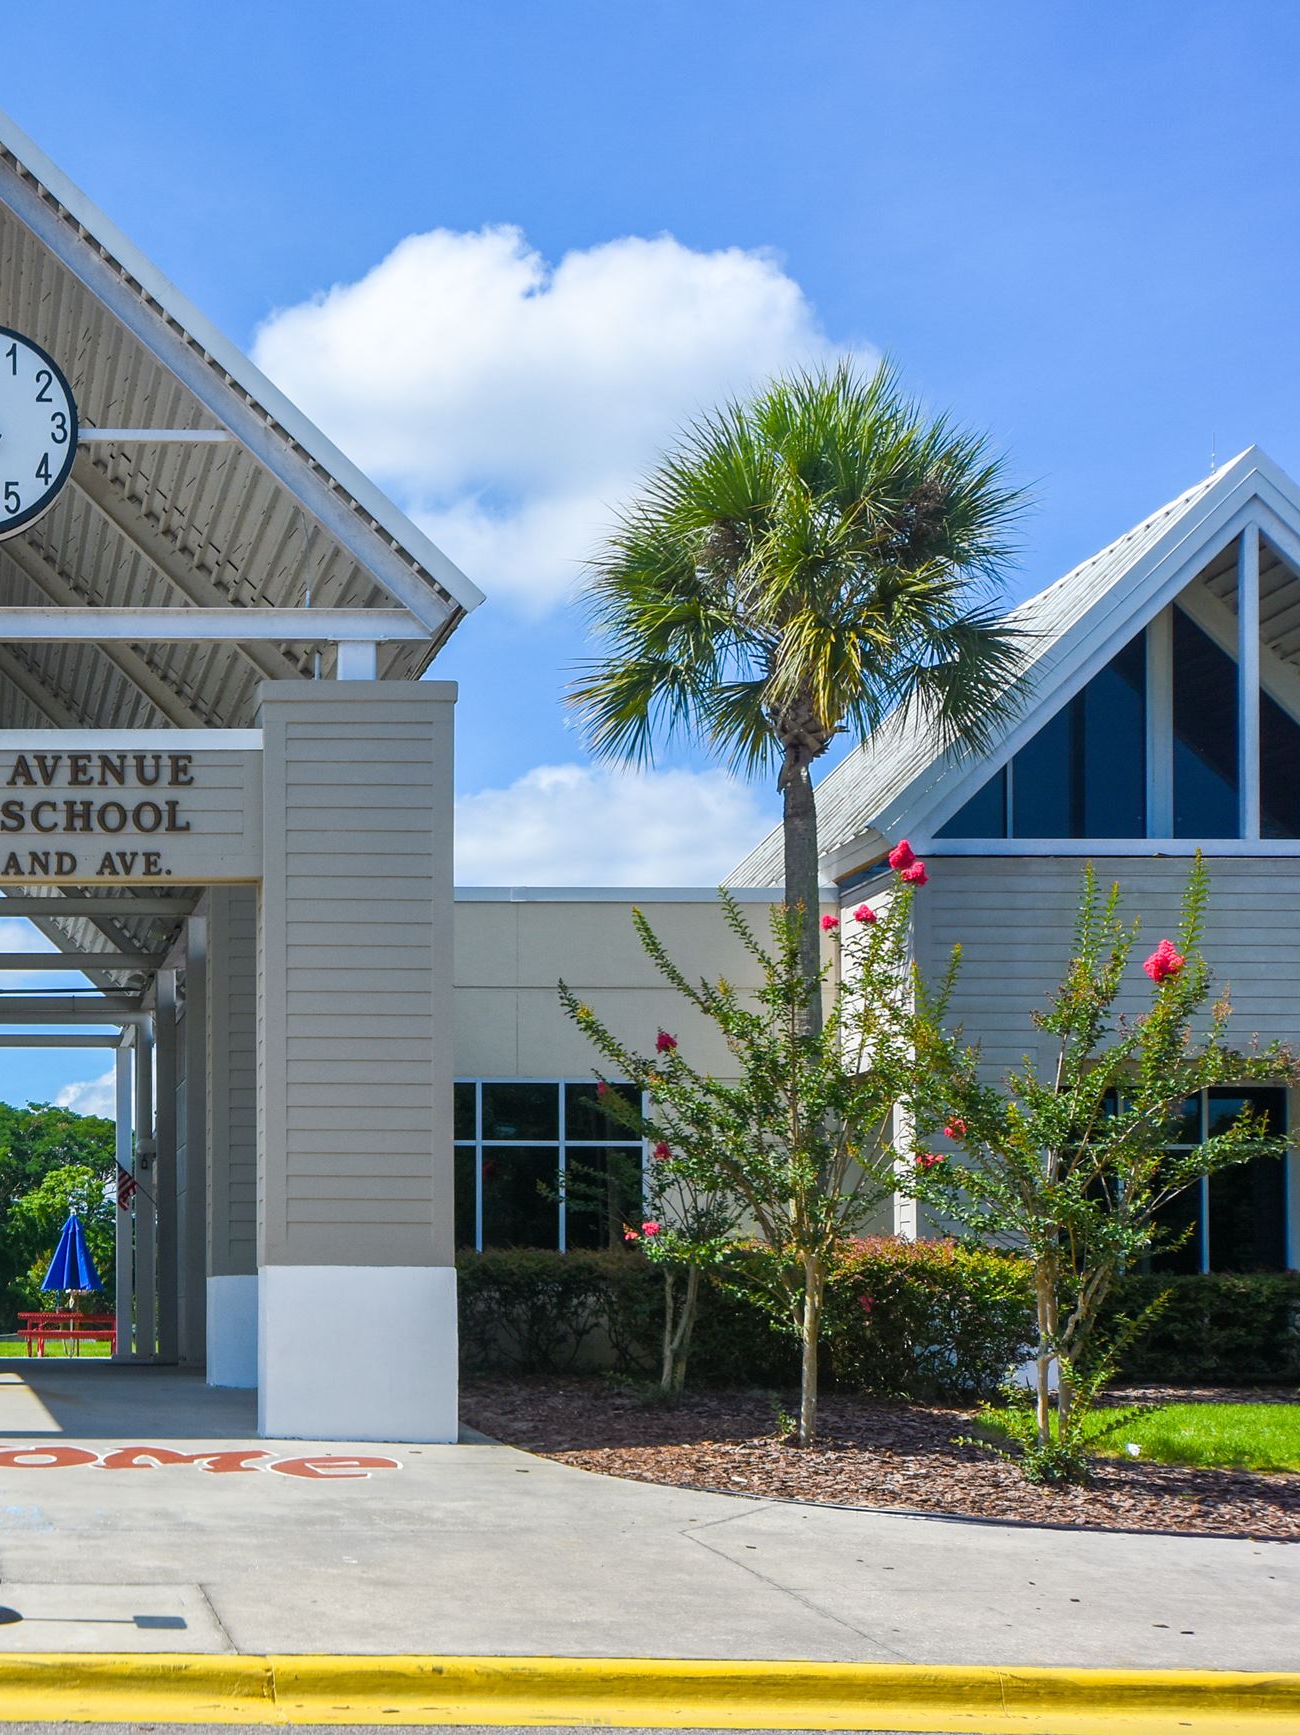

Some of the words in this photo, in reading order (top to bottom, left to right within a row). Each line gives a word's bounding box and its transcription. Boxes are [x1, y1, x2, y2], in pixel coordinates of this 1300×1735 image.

[5, 343, 17, 376] 1
[35, 369, 53, 403] 2
[50, 411, 68, 444] 3
[35, 452, 52, 486] 4
[4, 481, 21, 515] 5
[6, 754, 195, 786] AVENUE
[0, 800, 191, 833] SCHOOL
[96, 851, 173, 876] AVE.
